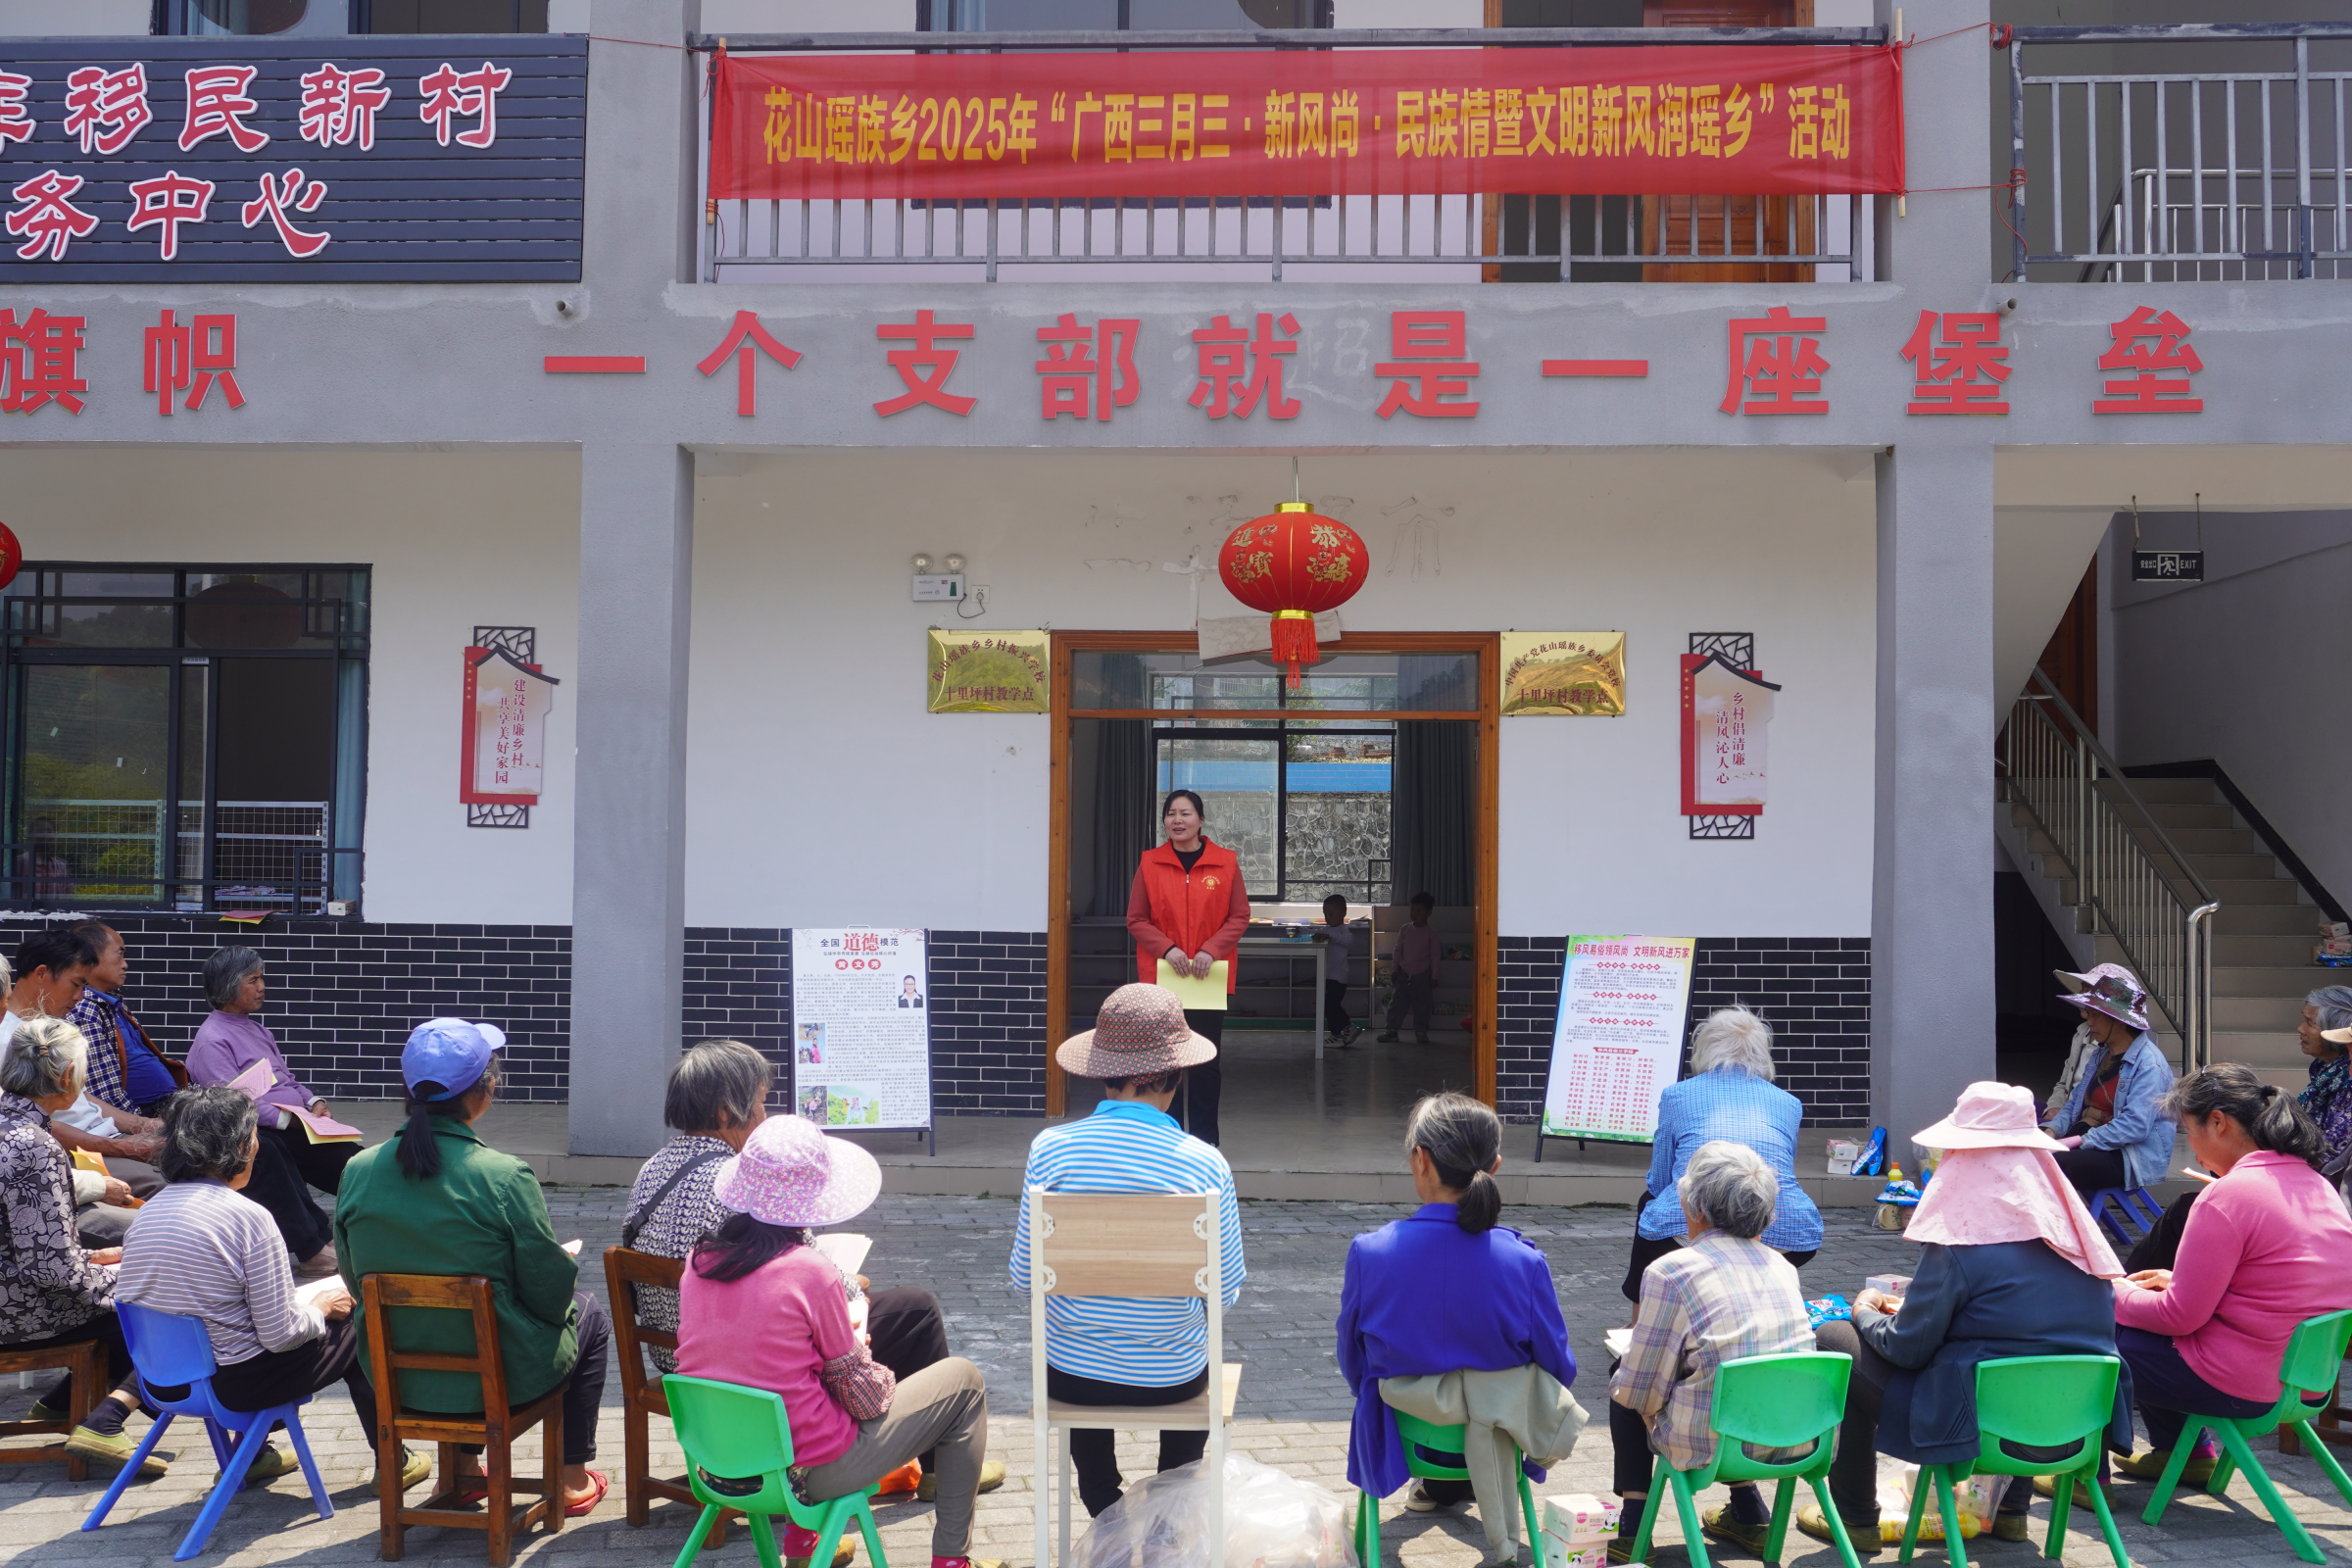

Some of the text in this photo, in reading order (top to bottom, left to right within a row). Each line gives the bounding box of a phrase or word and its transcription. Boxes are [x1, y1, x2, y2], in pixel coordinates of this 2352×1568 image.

[5, 168, 331, 262] 务中心
[0, 307, 246, 416] 旗帜
[545, 306, 2204, 420] 一个支部就是一座堡垒
[2180, 560, 2196, 568] EXIT
[932, 638, 1046, 683] 花山瑶族乡乡村振兴学校
[1504, 640, 1621, 688] 中国共产党花山瑶族乡委员会党校
[944, 686, 1035, 702] 十里坪村教学点
[1517, 688, 1609, 704] 十里坪村教学点
[495, 697, 511, 784] 共享美好家园
[512, 678, 526, 766] 建设清廉乡村
[1732, 691, 1746, 766] 乡村倡清廉
[1716, 710, 1730, 784] 清风沁人心
[820, 933, 899, 952] 全国道德模范
[1574, 943, 1690, 958] 移风易俗领风尚 文明新风进万家
